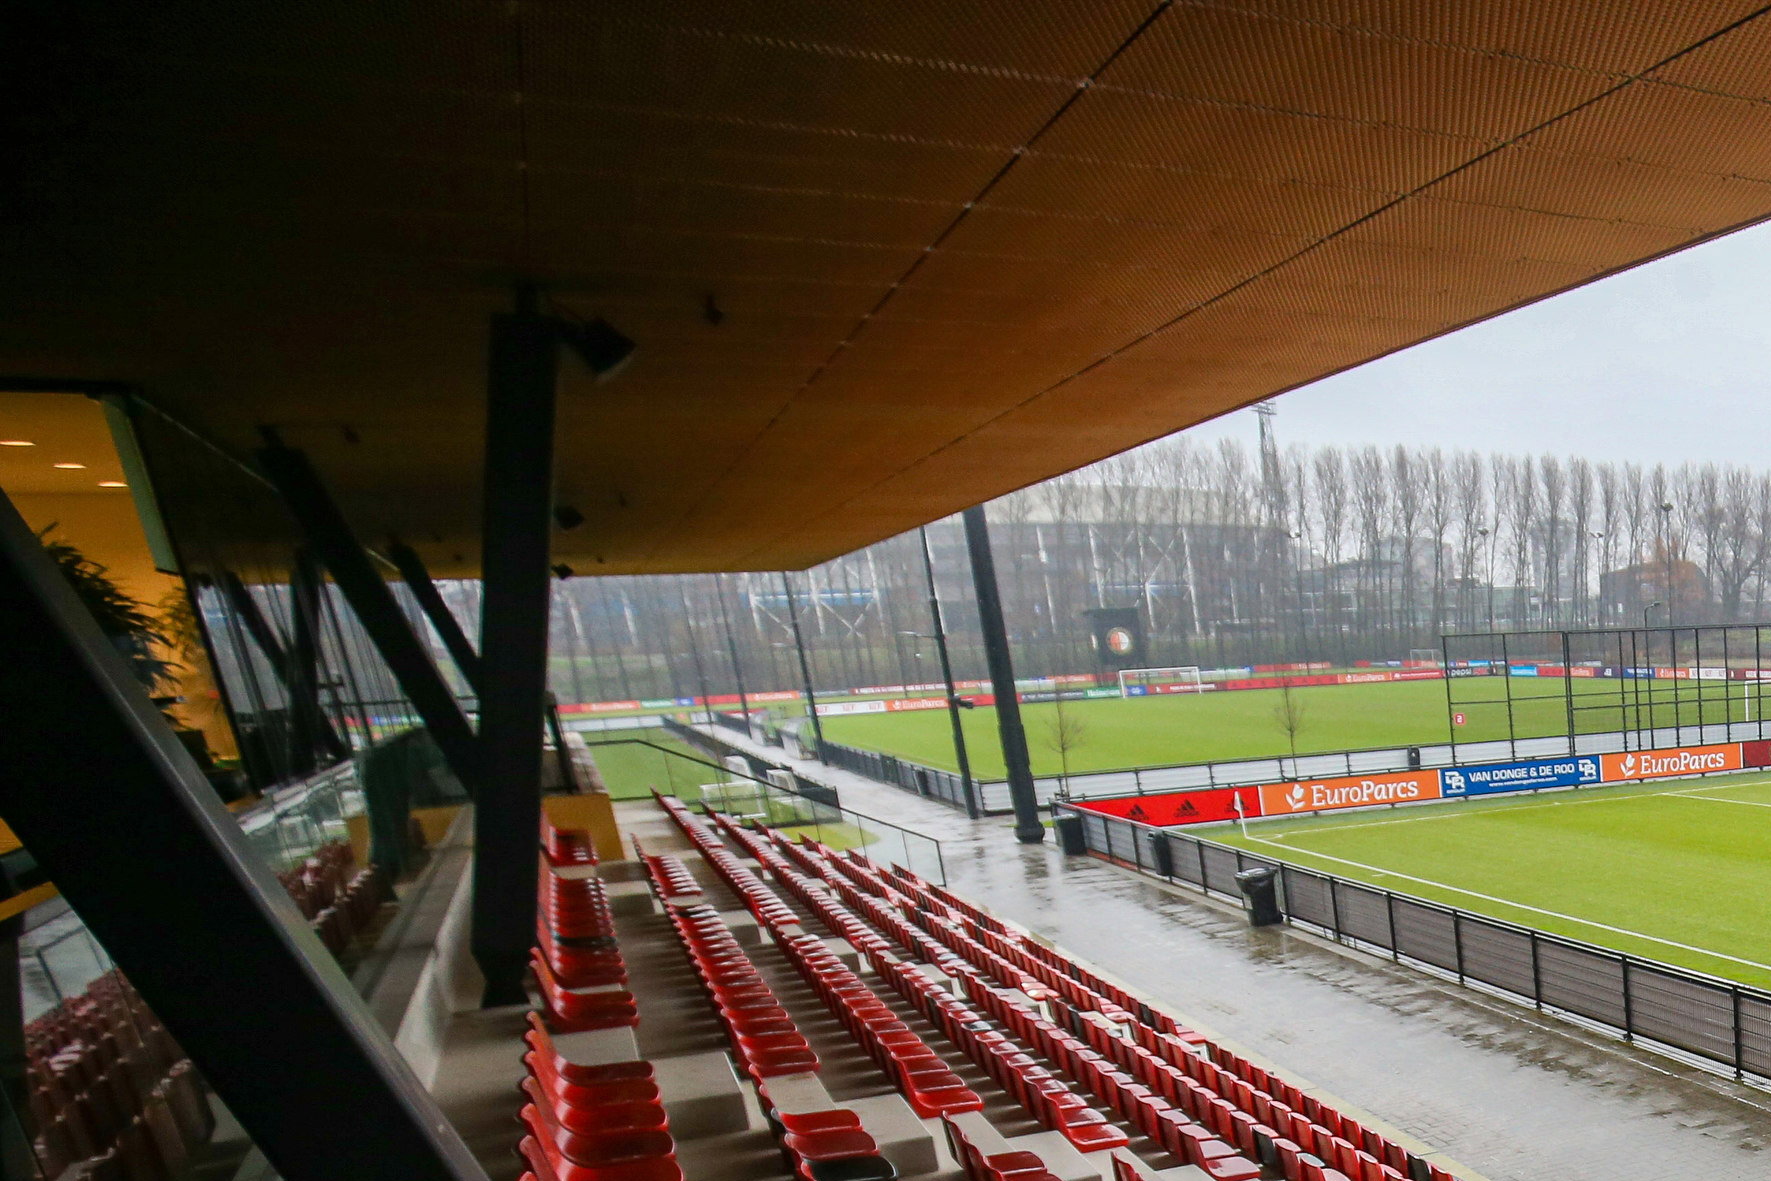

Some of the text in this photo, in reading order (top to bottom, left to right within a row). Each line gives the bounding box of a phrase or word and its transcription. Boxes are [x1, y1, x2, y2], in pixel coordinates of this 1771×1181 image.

[1469, 763, 1575, 782] VAN DONGE & DE ROO
[1640, 752, 1725, 774] EuroParcs
[1311, 780, 1419, 807] EuroParcs
